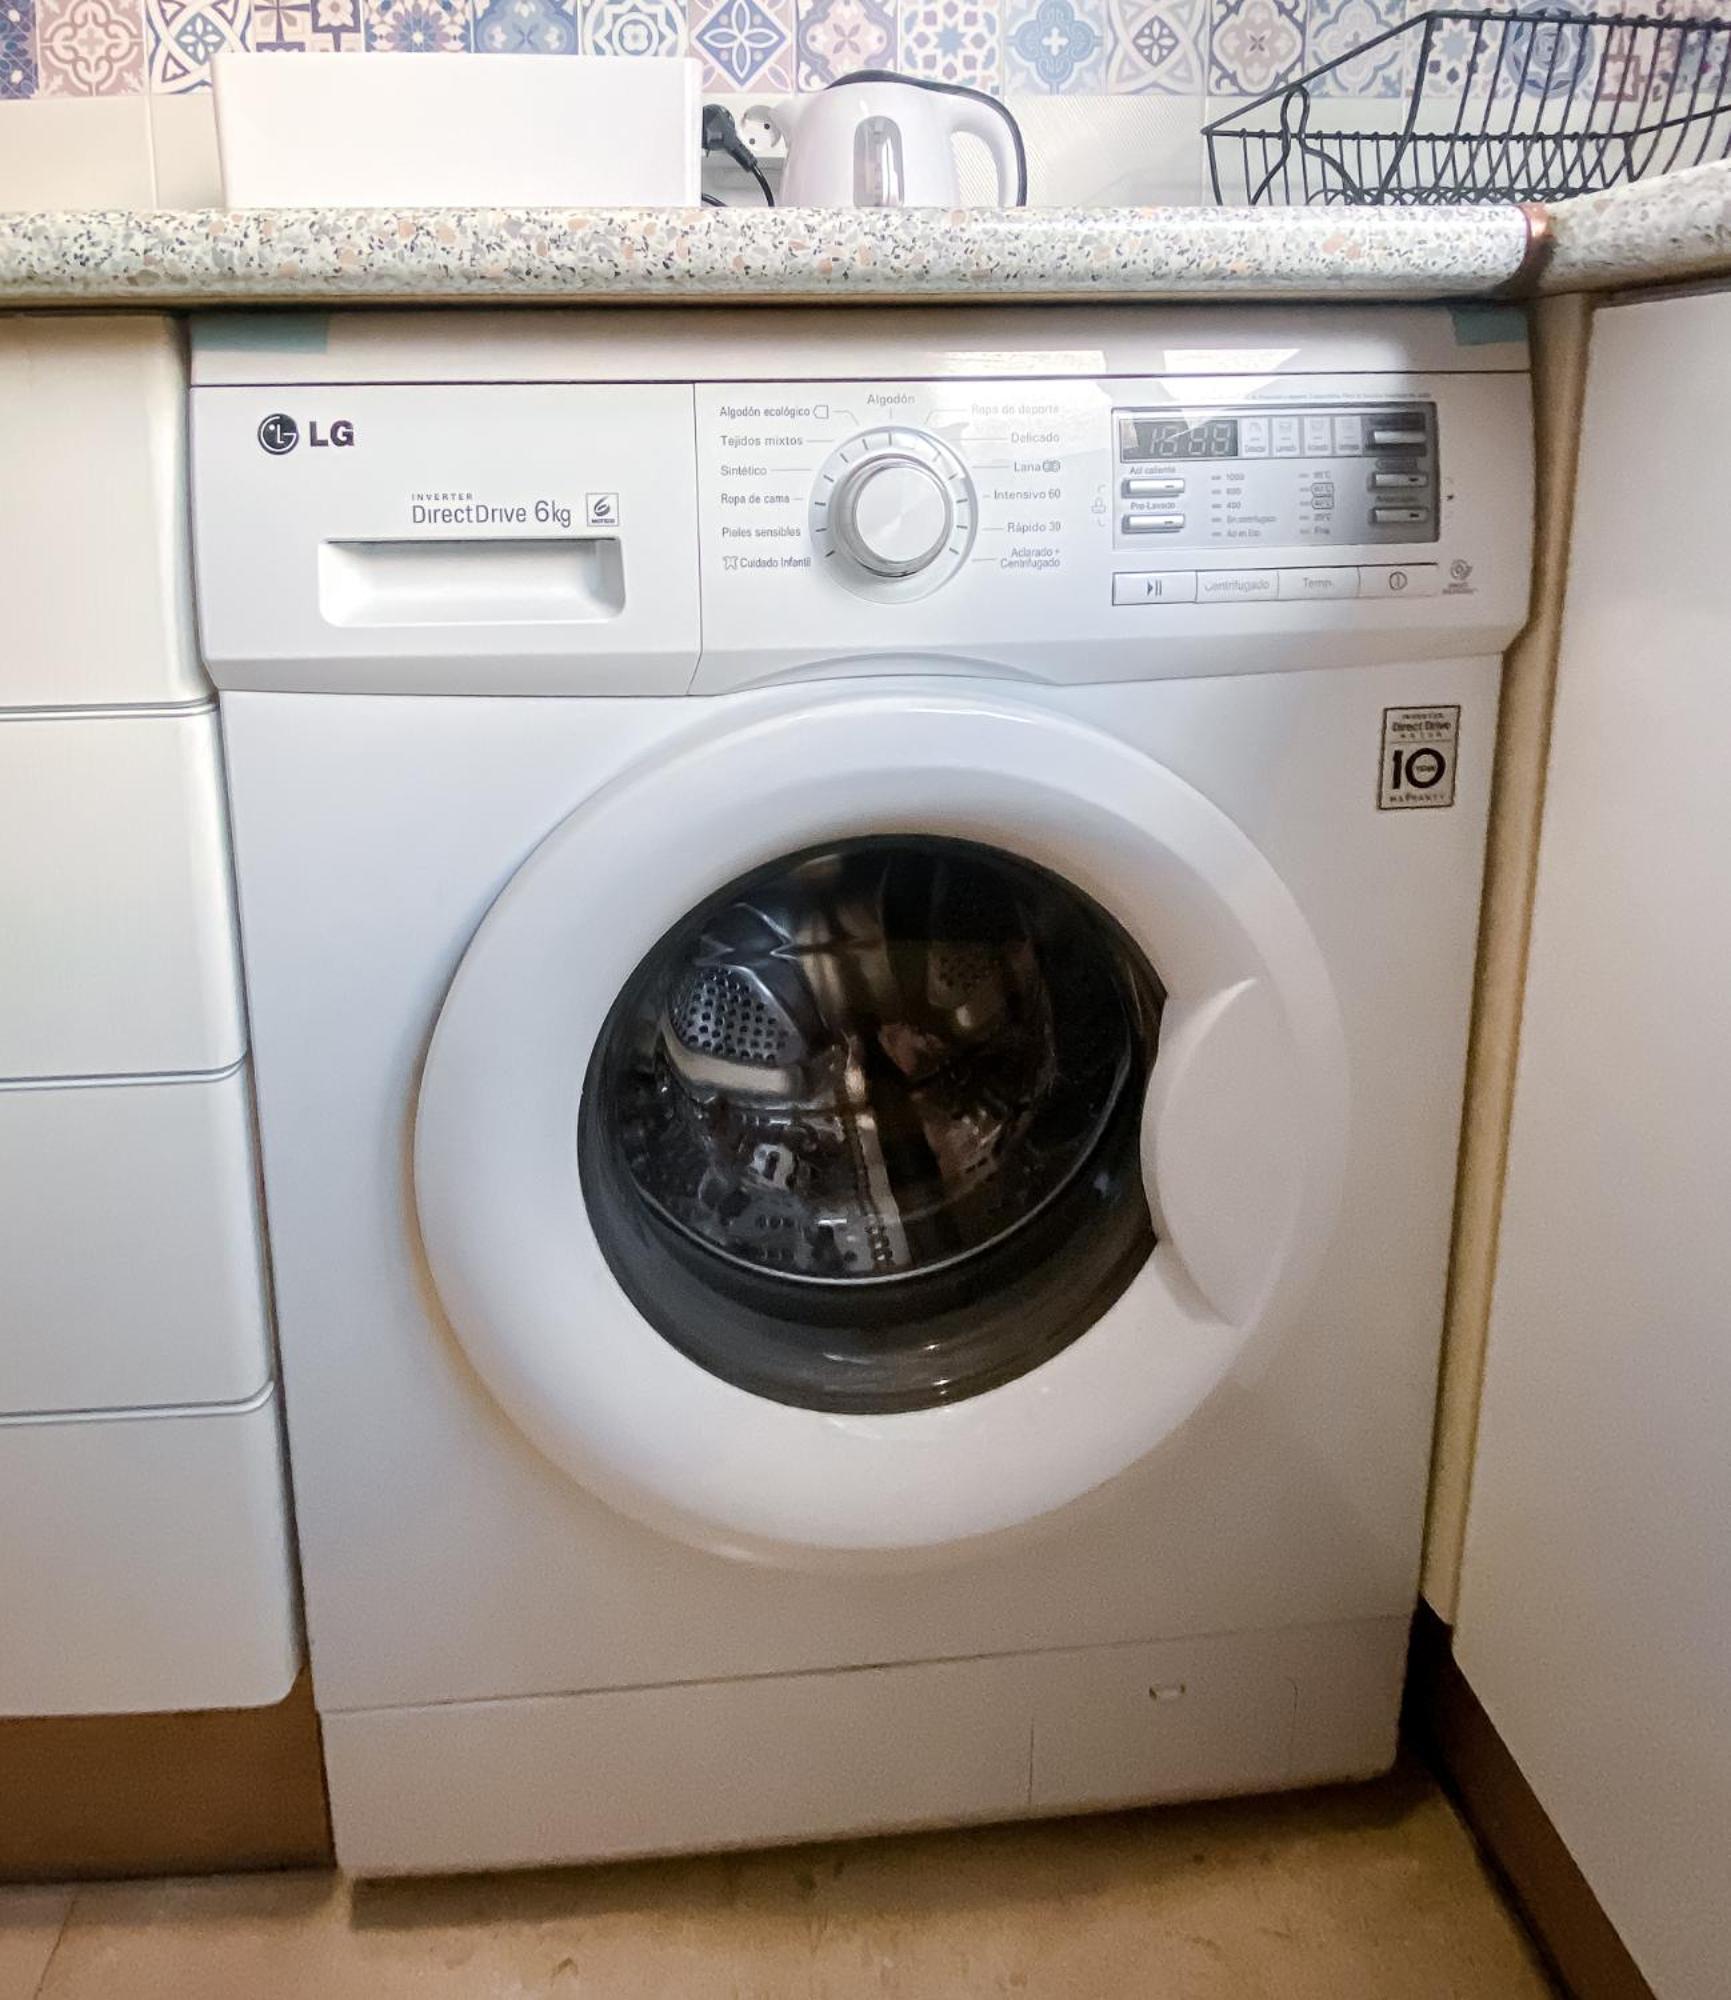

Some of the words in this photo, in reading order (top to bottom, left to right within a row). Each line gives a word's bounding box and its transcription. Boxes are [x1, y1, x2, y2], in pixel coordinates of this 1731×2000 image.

[867, 393, 915, 407] Algodón
[719, 406, 760, 419] Algodón
[764, 406, 810, 419] ecológico
[309, 420, 354, 447] LG
[1010, 432, 1060, 443] Delicado
[720, 435, 761, 448] Tejidos
[765, 436, 803, 447] mixtos
[720, 465, 768, 476] Sintético
[1014, 461, 1041, 472] Lana
[721, 493, 746, 506] Ropa
[748, 493, 761, 504] de
[764, 495, 790, 504] cama
[994, 489, 1046, 500] Intensivo
[1048, 488, 1061, 499] 60
[722, 527, 751, 537] Pieles
[755, 527, 801, 537] sensibles
[1007, 522, 1046, 534] Rápido
[1049, 521, 1061, 532] 30
[1011, 547, 1053, 558] Aclarado
[739, 556, 778, 568] Cuidado
[781, 556, 811, 568] Infantil
[1000, 558, 1061, 570] Centrifugado
[1392, 747, 1446, 790] 10
